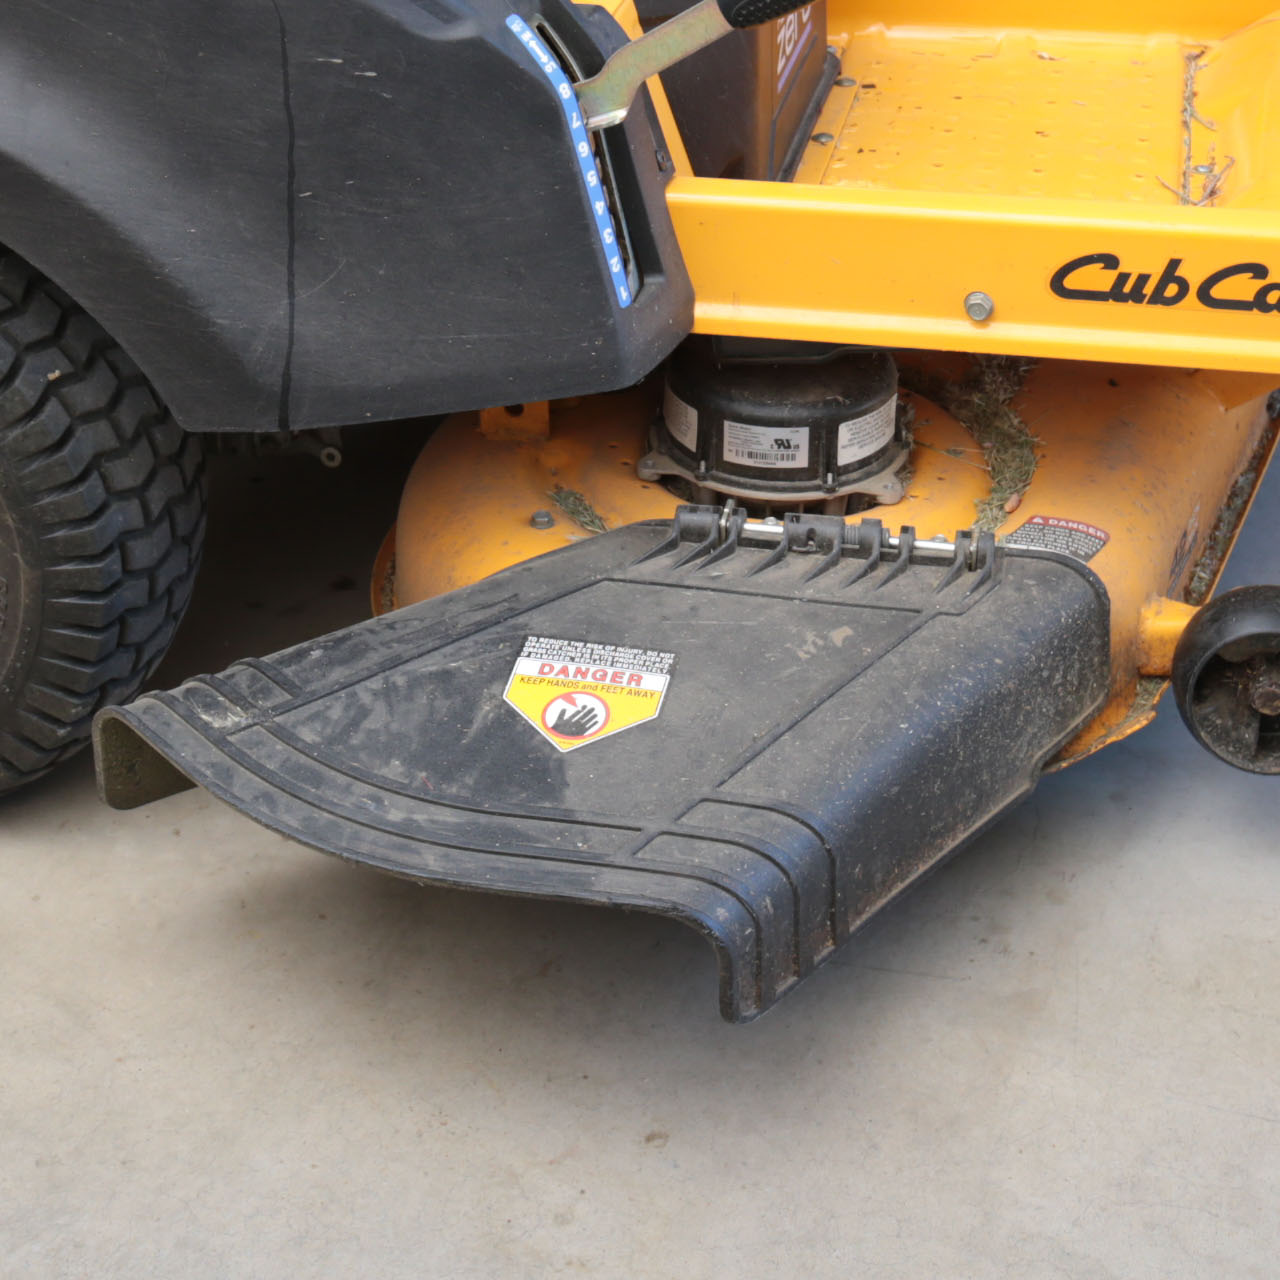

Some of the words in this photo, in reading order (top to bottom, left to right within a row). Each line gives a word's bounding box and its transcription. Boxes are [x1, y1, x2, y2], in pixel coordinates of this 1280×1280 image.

[558, 83, 572, 100] 8
[571, 111, 581, 129] 7
[578, 141, 589, 158] 6
[587, 171, 598, 187] 5
[595, 200, 605, 216] 4
[603, 228, 614, 244] 3
[609, 256, 620, 273] 2
[620, 285, 628, 301] 1
[1050, 253, 1190, 306] Cub
[1048, 519, 1106, 538] DANGER
[525, 641, 560, 650] OPERATE
[561, 645, 591, 654] UNLESS
[593, 649, 634, 659] DISCHARGE
[636, 655, 661, 663] COVER
[539, 637, 569, 645] REDUCE
[523, 646, 546, 654] GRASS
[547, 650, 581, 658] CATCHER
[613, 657, 644, 665] PROPER
[574, 657, 612, 666] REPLACE
[538, 663, 644, 687] DANGER
[519, 676, 546, 686] KEEP
[546, 679, 580, 690] HANDS
[581, 683, 598, 691] and
[600, 685, 624, 695] FEET
[626, 688, 656, 699] AWAY
